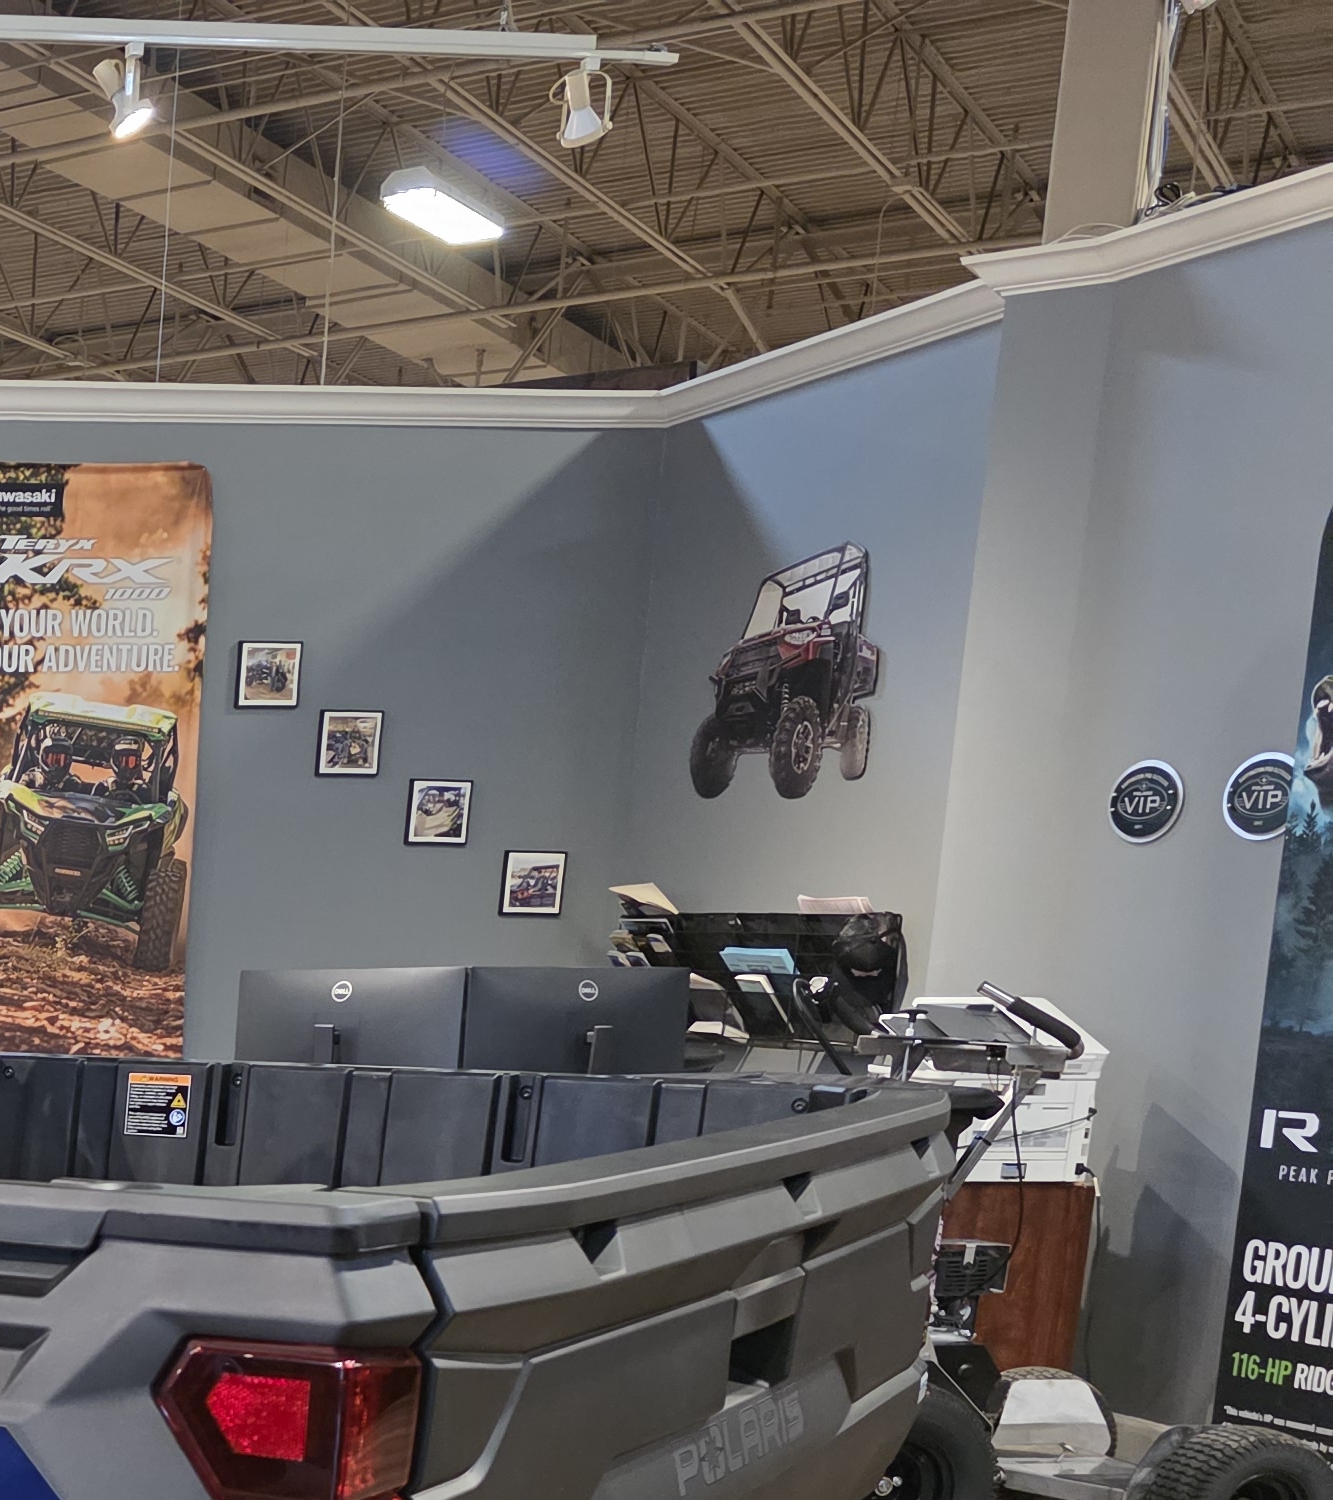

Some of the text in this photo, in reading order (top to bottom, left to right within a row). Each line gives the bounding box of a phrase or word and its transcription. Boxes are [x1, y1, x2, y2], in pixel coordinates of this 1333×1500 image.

[7, 505, 23, 514] good
[104, 587, 172, 600] 1000
[0, 609, 158, 637] YOUR WORLD.
[42, 644, 180, 673] ADVENTURE.
[1124, 796, 1161, 814] VIP
[1242, 790, 1282, 809] VIP
[1278, 1165, 1318, 1184] PEAK
[1243, 1238, 1333, 1295] GROU
[1234, 1290, 1333, 1349] 4-CYLI
[1231, 1352, 1293, 1386] 116-HP
[670, 1381, 805, 1497] POLARIS
